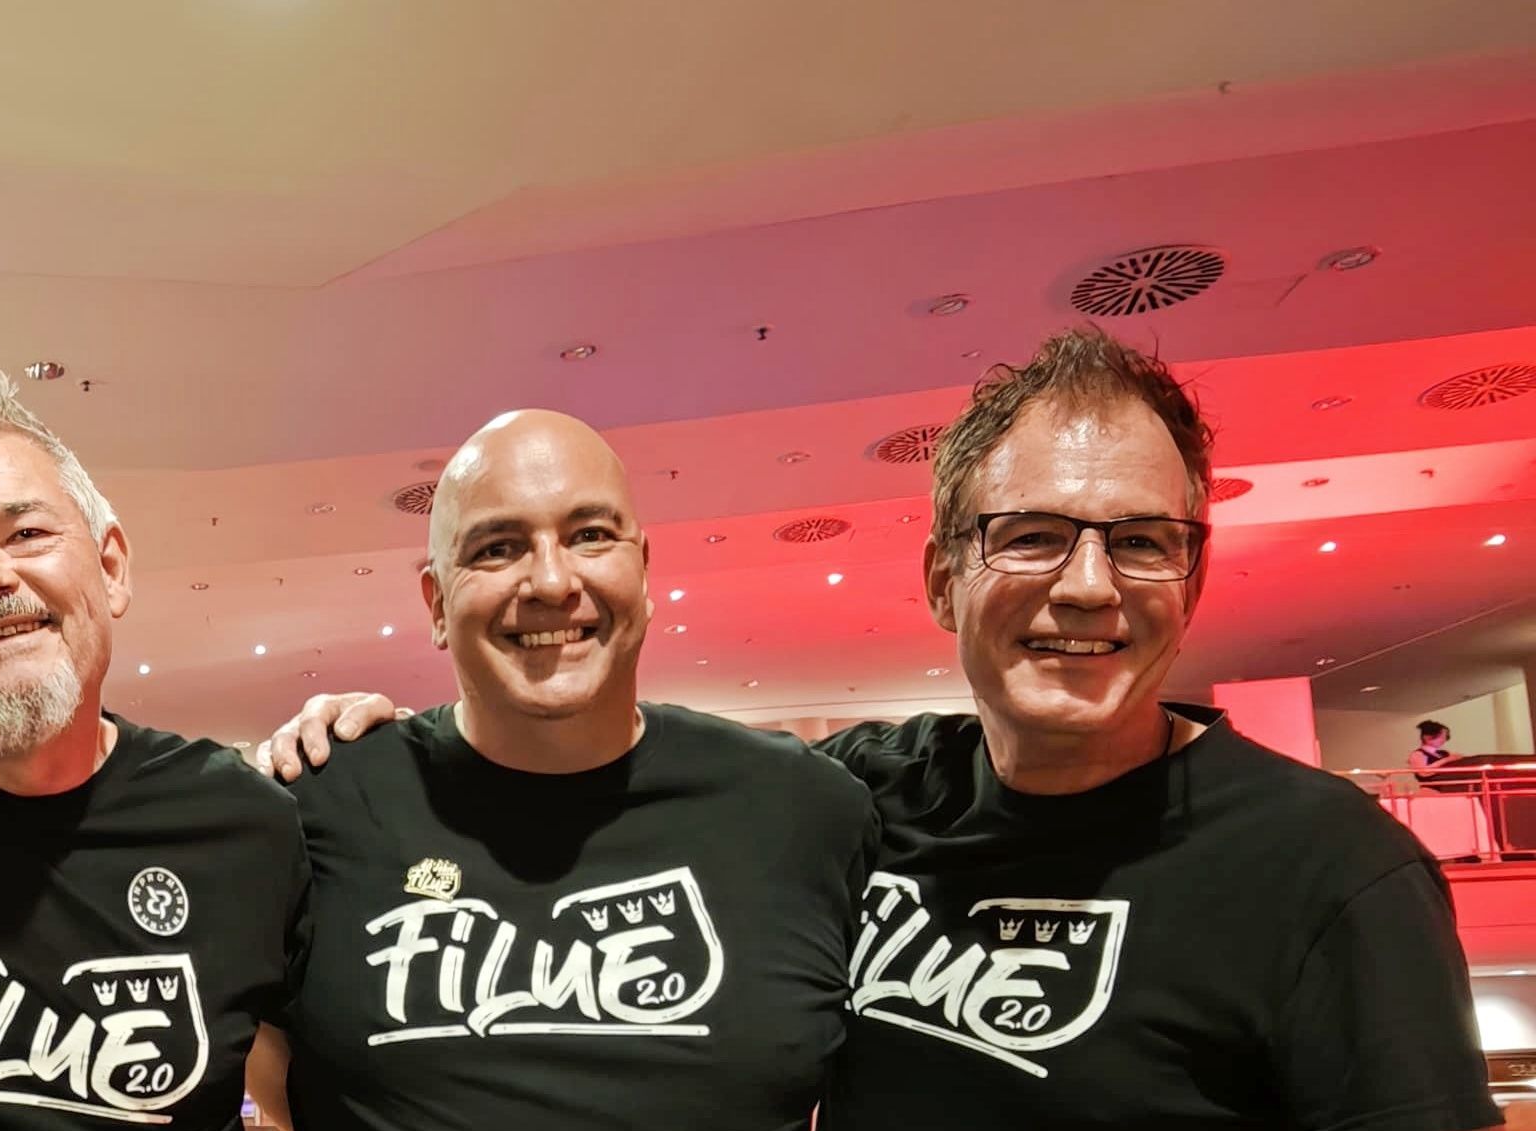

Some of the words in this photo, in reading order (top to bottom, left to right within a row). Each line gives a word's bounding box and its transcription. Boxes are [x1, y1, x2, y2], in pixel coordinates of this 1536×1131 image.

[636, 971, 685, 1006] 2.0
[994, 999, 1052, 1032] 2.0
[125, 1062, 175, 1094] 2.0
